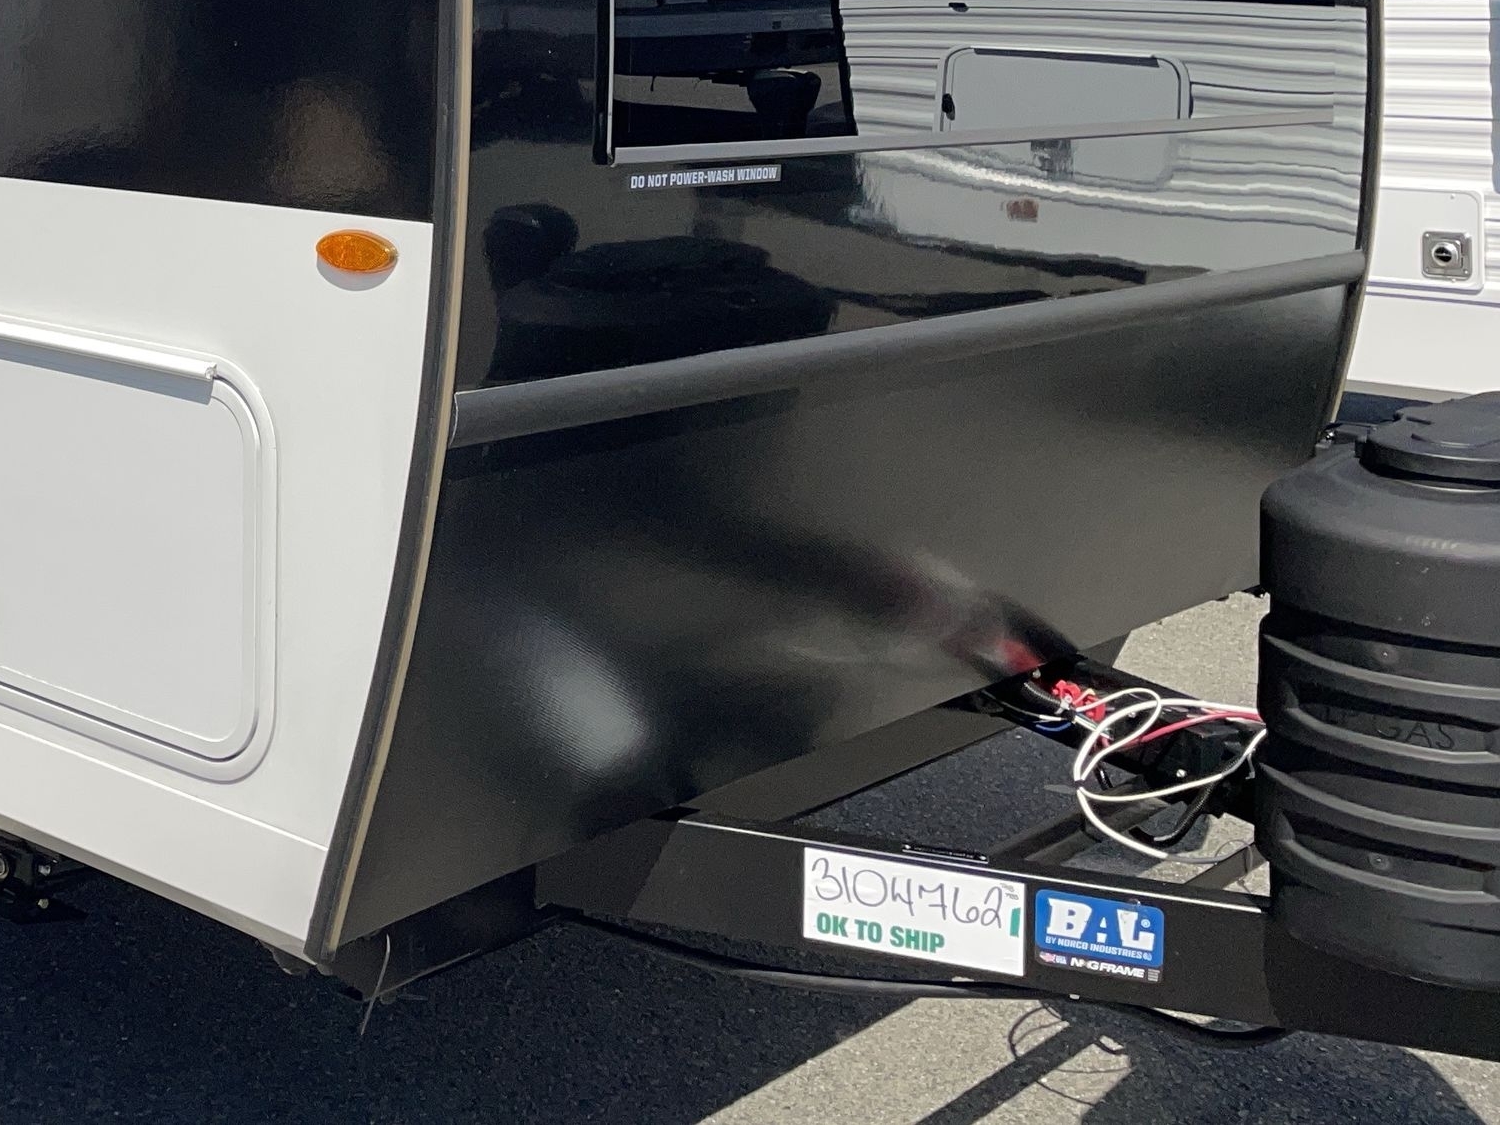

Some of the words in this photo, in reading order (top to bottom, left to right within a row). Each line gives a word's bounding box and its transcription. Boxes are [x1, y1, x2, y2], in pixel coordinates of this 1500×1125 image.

[630, 176, 645, 189] DO
[647, 174, 668, 187] NOT
[669, 169, 735, 186] POWER-WASH
[737, 167, 778, 181] WINDOW
[812, 857, 1002, 929] 3104762
[816, 912, 849, 938] OK
[854, 918, 882, 943] TO
[890, 925, 945, 954] SHIP
[1046, 898, 1155, 951] BAL
[1045, 935, 1057, 945] BY
[1057, 937, 1088, 950] NORCO
[1090, 943, 1144, 960] INDUSTRIES
[1099, 961, 1145, 978] FRAME
